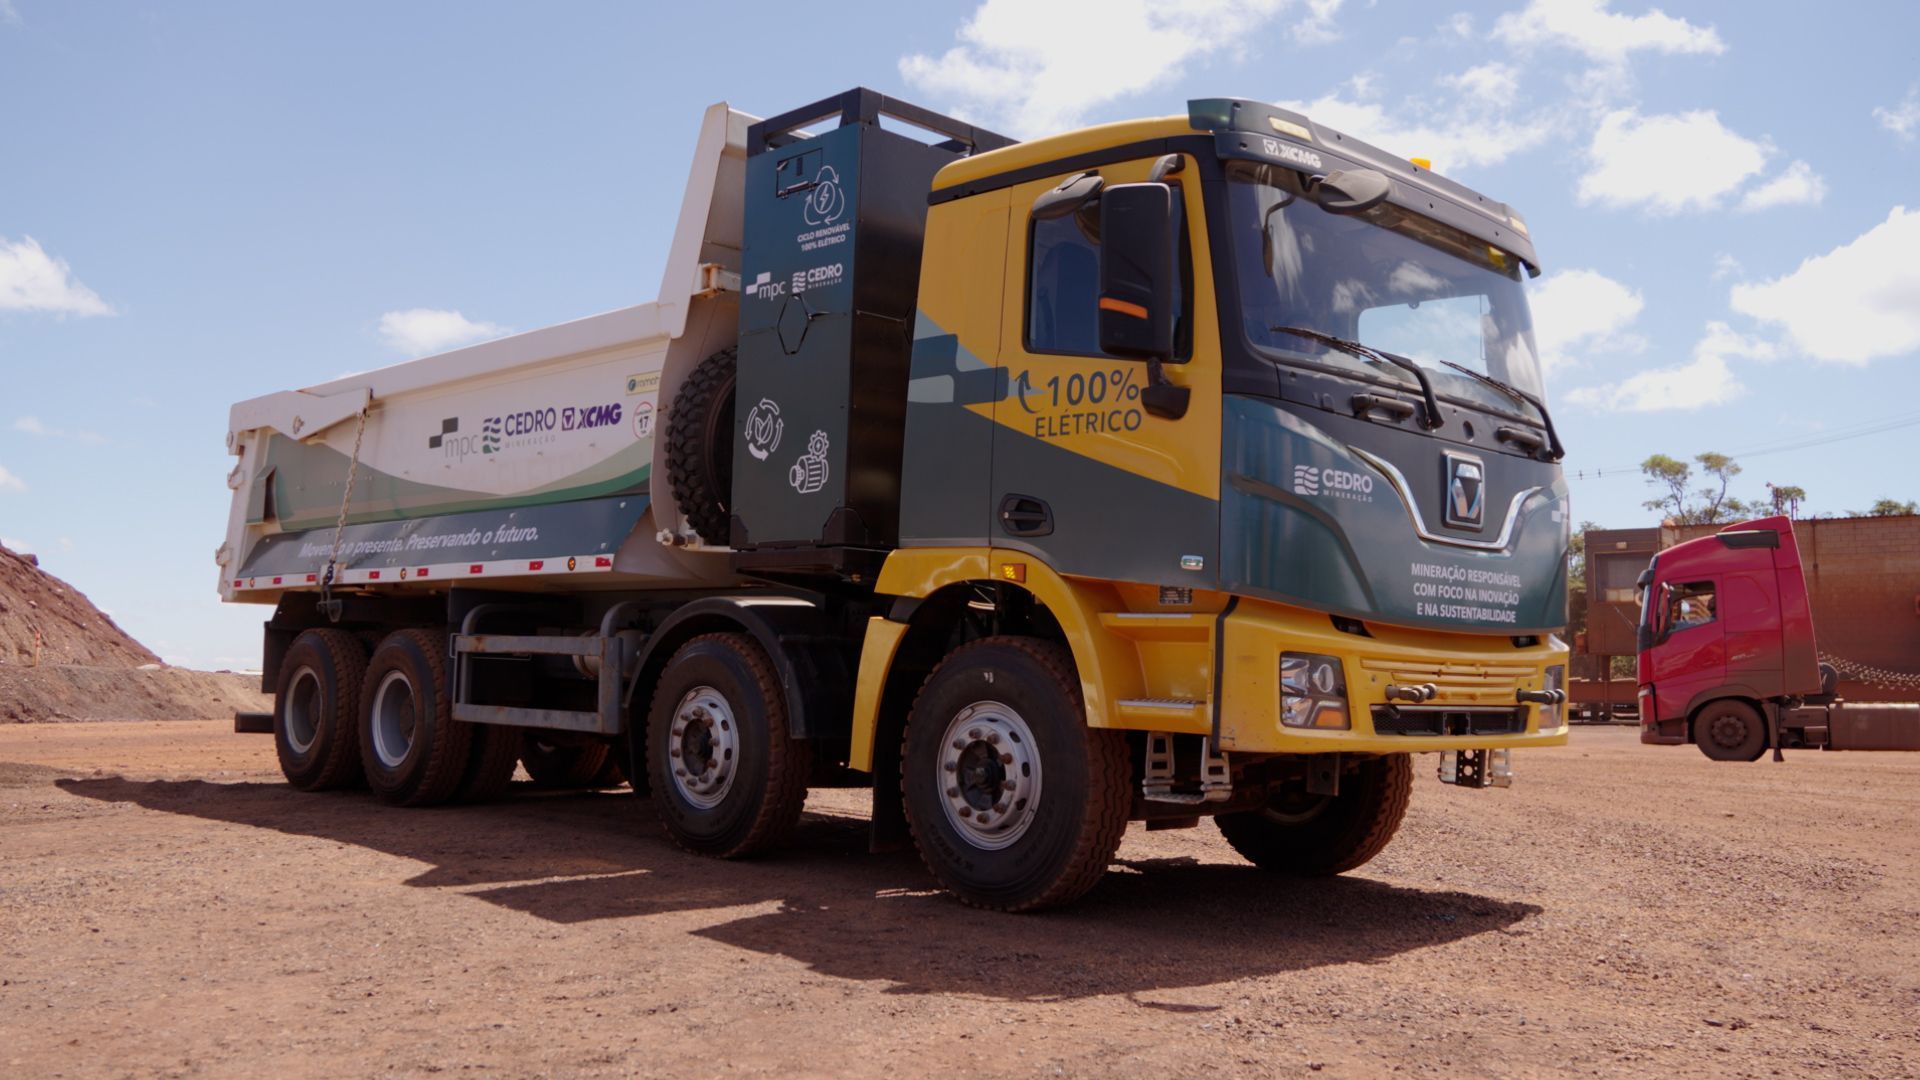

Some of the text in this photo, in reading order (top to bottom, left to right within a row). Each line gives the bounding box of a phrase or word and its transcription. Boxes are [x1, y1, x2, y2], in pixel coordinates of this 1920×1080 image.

[1279, 143, 1322, 168] XCMG
[797, 223, 850, 243] CICLO RENOVÁVEL
[818, 234, 846, 248] ELÉTRICO
[759, 263, 843, 301] mpc CEDRO
[1047, 367, 1140, 407] 100%
[445, 402, 622, 462] mpc CEDRO XCMG
[1035, 408, 1142, 438] ELÉTRICO
[1322, 468, 1373, 493] CEDRO
[297, 539, 346, 558] Moveno
[352, 537, 403, 557] presente.
[405, 528, 481, 550] Preservando
[482, 531, 493, 544] o
[493, 524, 539, 543] futuro.
[1411, 563, 1521, 588] MINERAÇÃO RESPONSÁVEL
[1413, 583, 1519, 607] COM FOCO NA INOVAÇÃO
[1417, 602, 1516, 623] E NA SUSTENTABILIDADE
